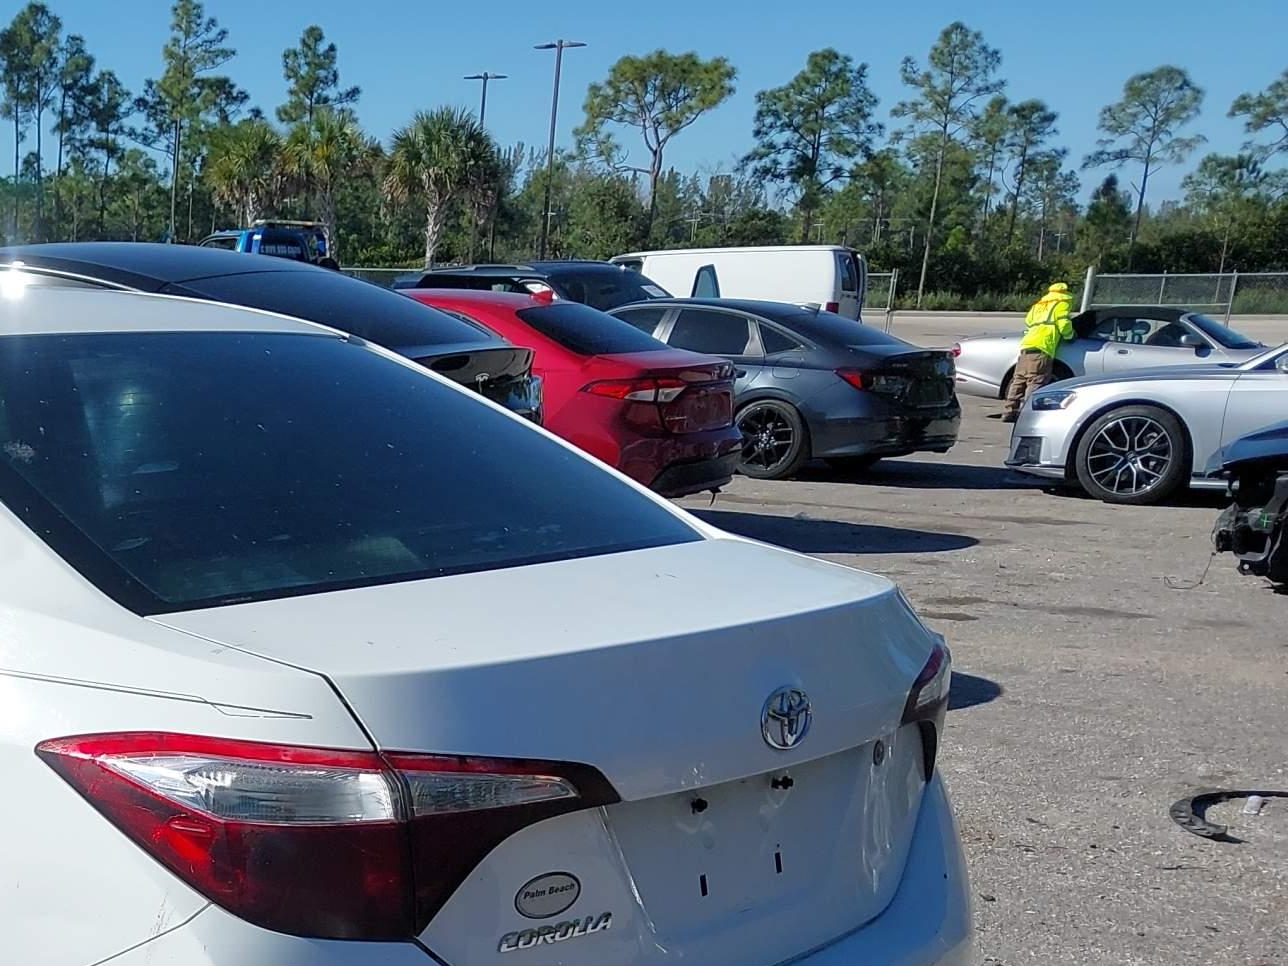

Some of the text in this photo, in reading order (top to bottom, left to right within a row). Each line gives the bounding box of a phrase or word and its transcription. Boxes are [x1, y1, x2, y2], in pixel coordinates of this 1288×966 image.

[523, 882, 576, 900] Palm Beach
[497, 911, 613, 953] COROLLA
